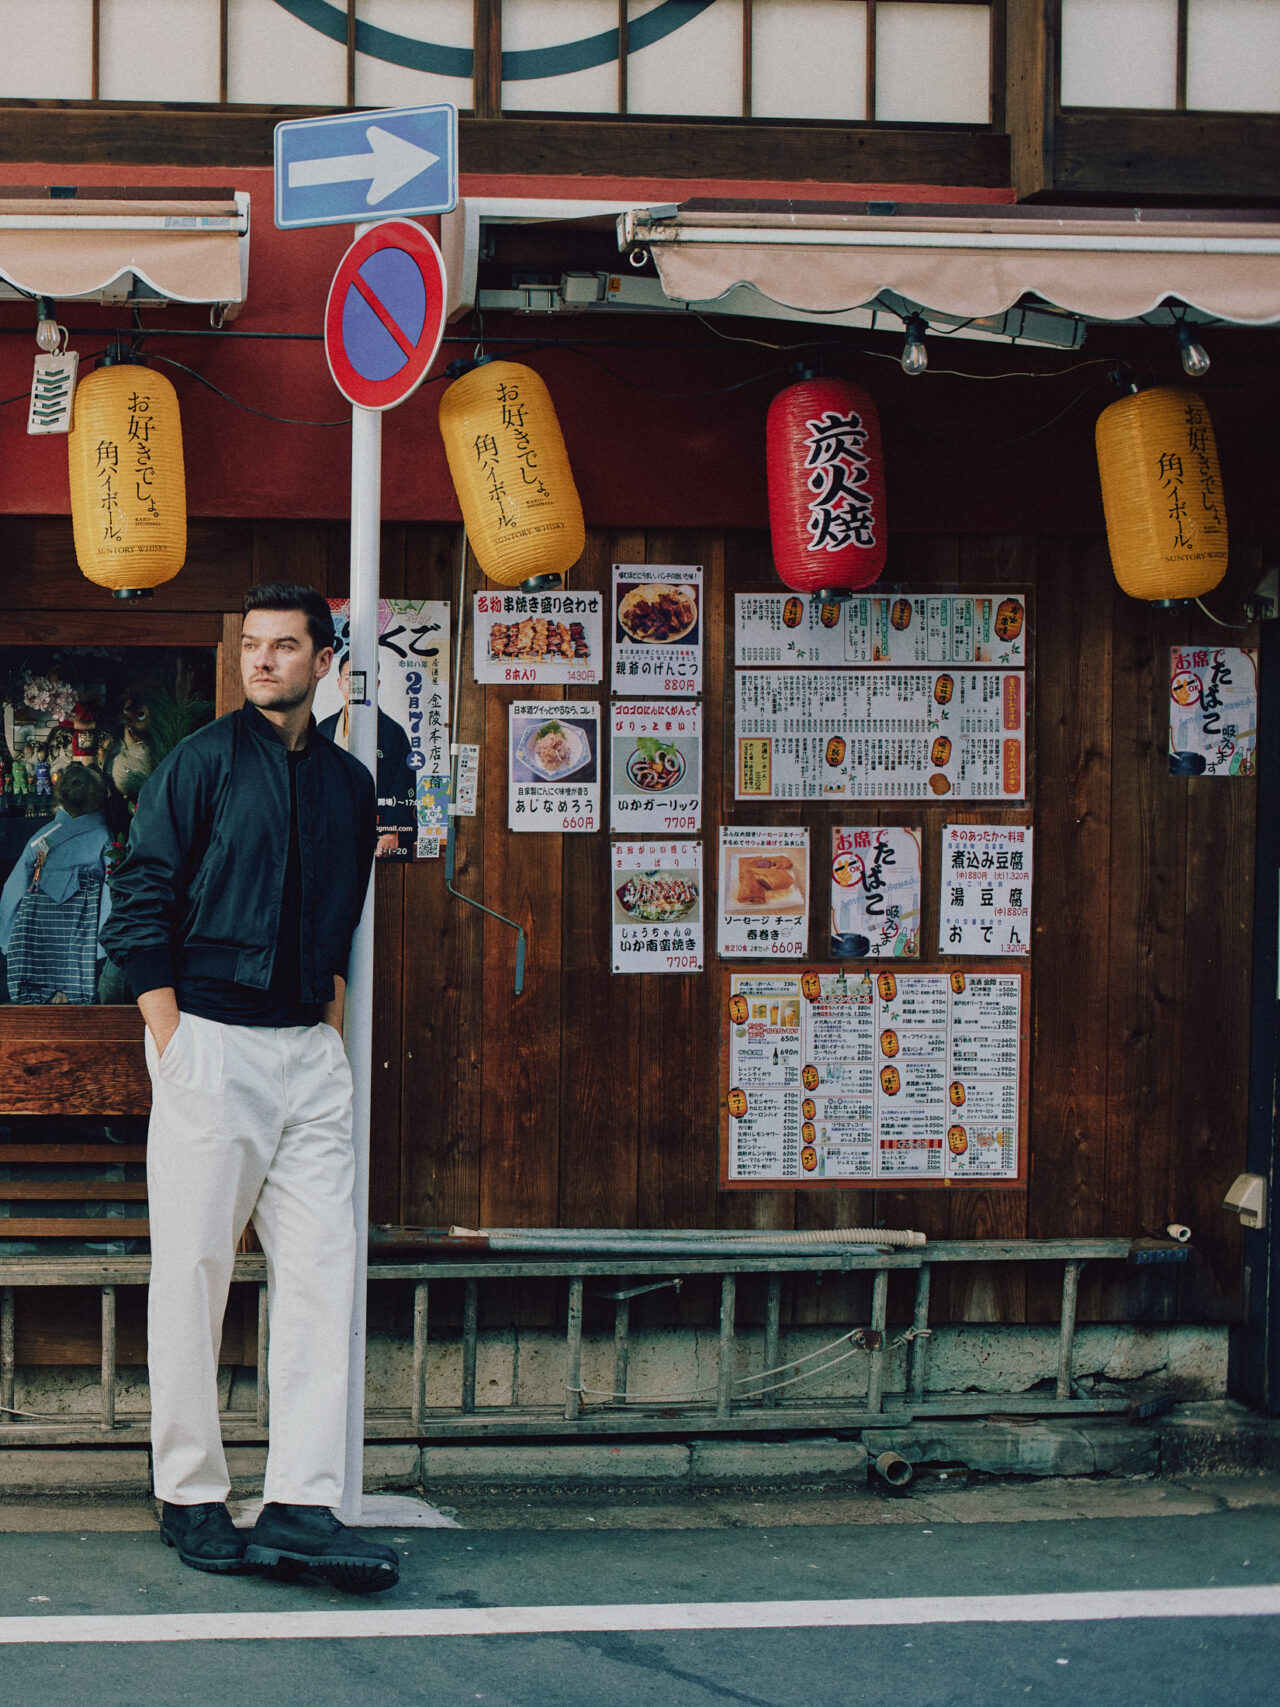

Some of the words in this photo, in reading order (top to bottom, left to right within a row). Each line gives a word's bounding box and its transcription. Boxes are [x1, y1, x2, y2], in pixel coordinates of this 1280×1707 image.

[496, 382, 550, 499] お好きでしょ。
[128, 391, 160, 518] お好きでしょ。
[472, 433, 517, 531] 角ハイボール。
[805, 411, 876, 552] 炭火焼
[95, 440, 122, 542] 角ハイボール。
[1156, 452, 1193, 550] 角ハイボール。
[494, 528, 533, 546] SUNTORY
[97, 545, 135, 555] SUNTORY
[137, 544, 168, 553] WHISKY
[478, 596, 599, 614] 名物串焼き盛り合わせ
[399, 660, 428, 668] 令和八年
[1175, 648, 1226, 670] お席で
[505, 668, 536, 681] 8本入り
[567, 670, 596, 682] 1430円
[615, 661, 699, 676] 親爺のげんこつ
[664, 679, 695, 691] 880円
[1188, 685, 1200, 693] OK
[1198, 660, 1232, 735] たばこ
[615, 705, 698, 716] ゴロゴロにんにくが入って
[1206, 724, 1236, 775] 吸えます
[517, 787, 589, 796] 自家製にんにく味噌が香る
[515, 800, 594, 813] あじなめろう
[618, 799, 699, 811] いかガーリック
[562, 817, 594, 829] 660円
[664, 817, 695, 829] 770円
[837, 829, 889, 851] お席で
[951, 849, 1024, 870] 煮込み豆腐
[860, 841, 896, 916] たばこ
[950, 887, 1023, 907] 湯豆腐
[724, 916, 770, 925] ソーセージ
[775, 916, 803, 925] チーズ
[621, 927, 692, 939] しょうちゃんの
[747, 929, 780, 941] 春巻き
[871, 905, 900, 956] 吸えます
[949, 924, 1021, 944] おでん
[620, 939, 696, 952] いか南蛮焼き
[771, 942, 803, 954] 660円
[666, 956, 698, 968] 770円
